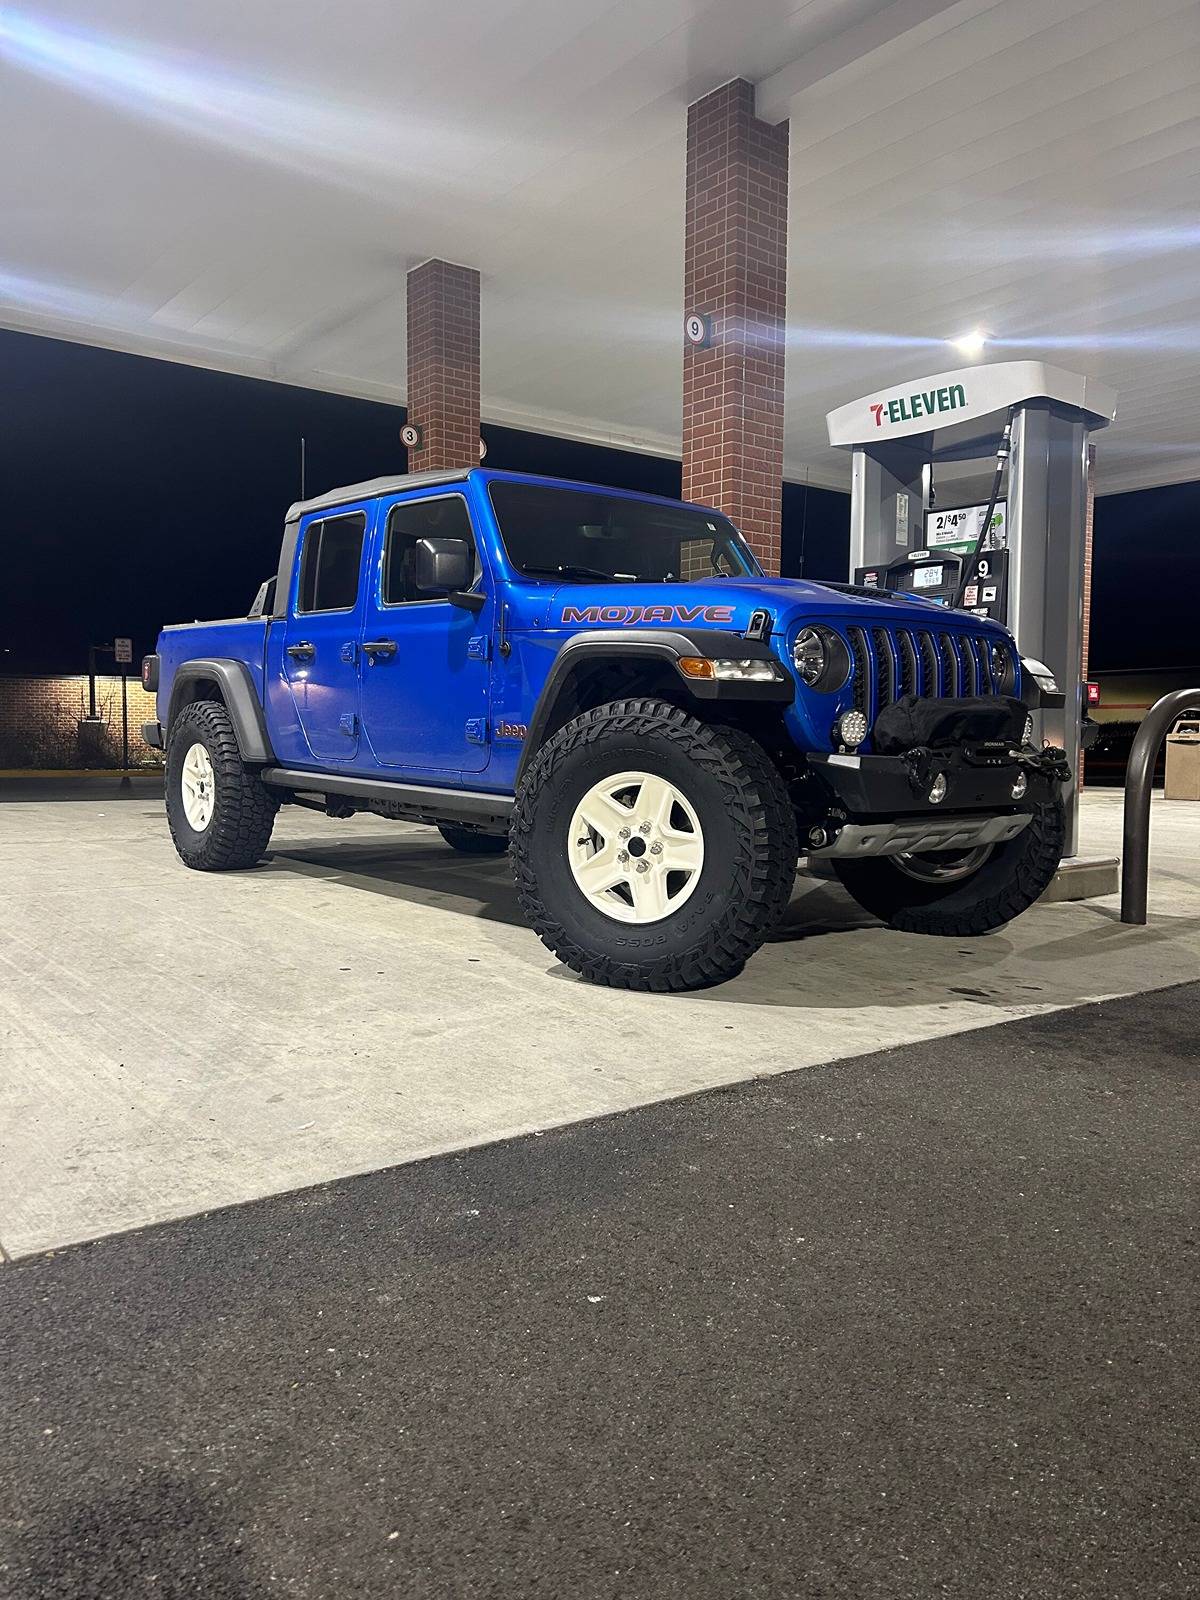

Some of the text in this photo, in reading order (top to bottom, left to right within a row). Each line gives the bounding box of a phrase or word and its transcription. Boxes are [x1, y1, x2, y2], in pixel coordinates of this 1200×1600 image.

[691, 321, 699, 336] 9
[406, 430, 414, 442] 3
[978, 560, 989, 578] 9
[562, 605, 736, 625] MOJAVE
[495, 720, 528, 741] Jeep
[615, 934, 668, 948] BOSS
